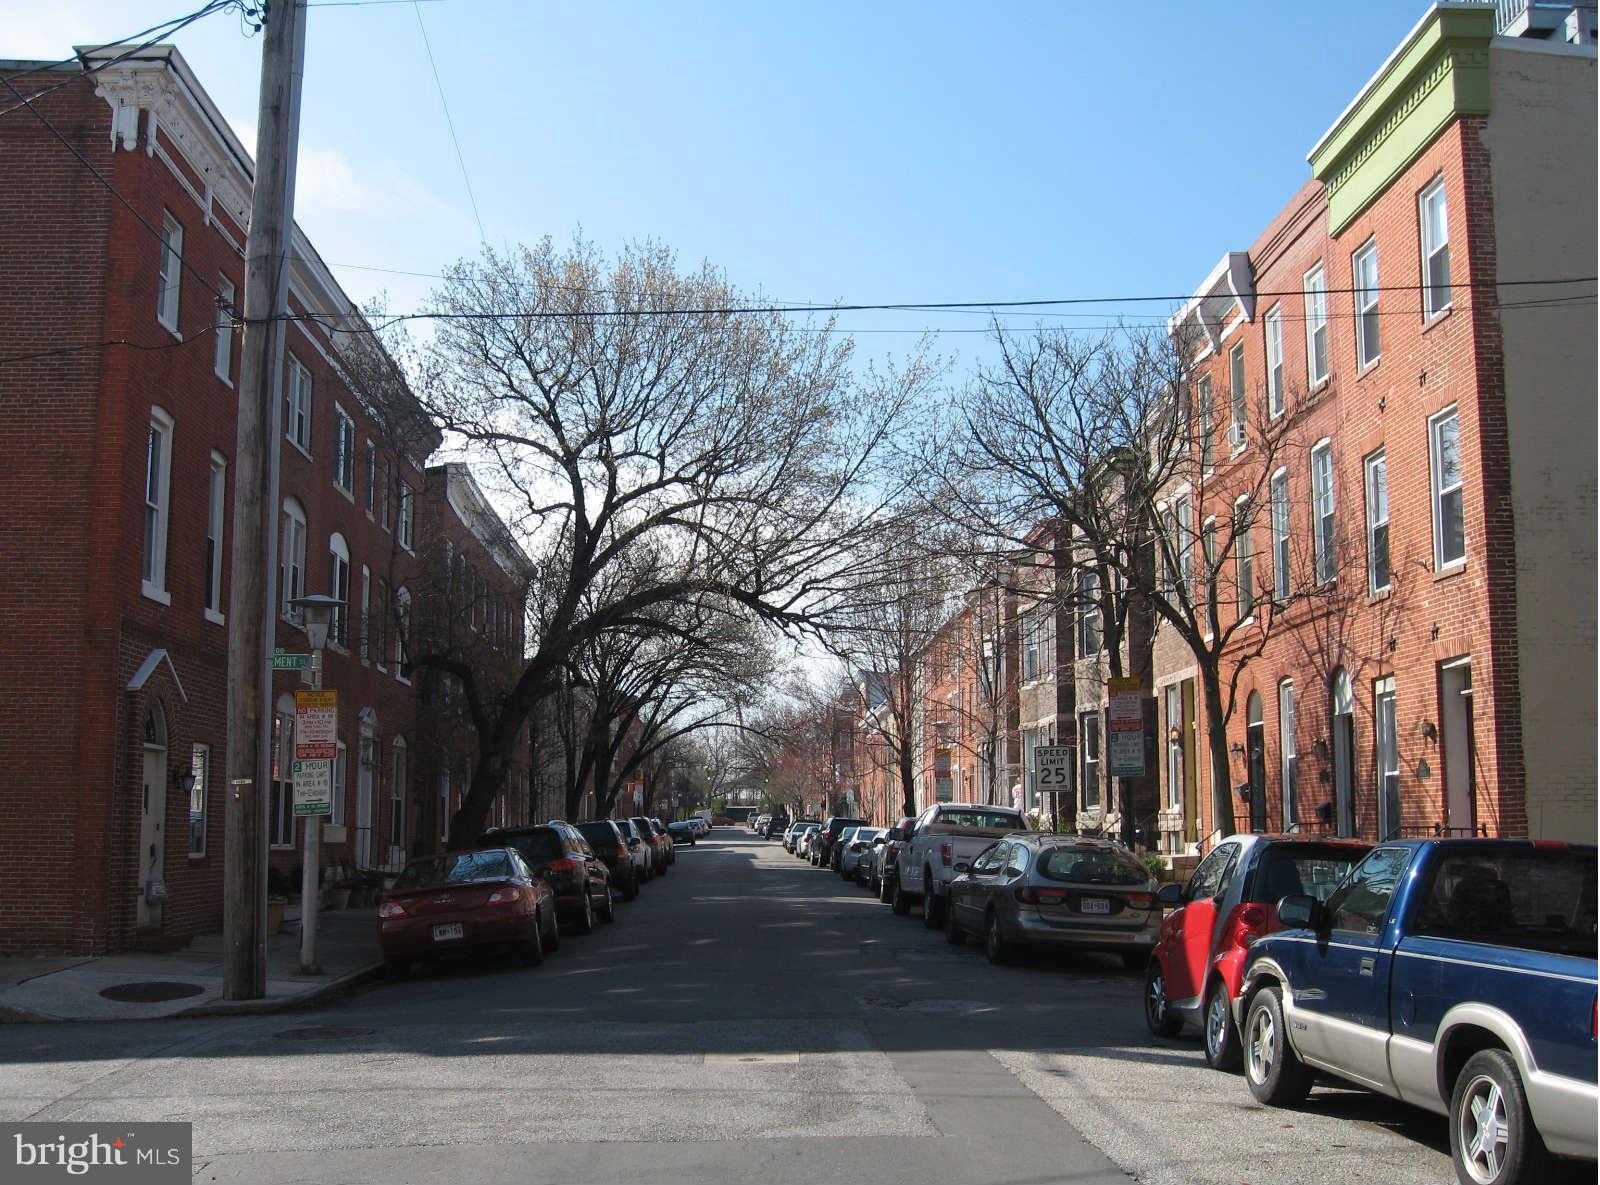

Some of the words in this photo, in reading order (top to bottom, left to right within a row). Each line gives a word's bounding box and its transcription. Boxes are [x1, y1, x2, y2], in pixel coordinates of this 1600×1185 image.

[272, 656, 297, 667] MENT
[1037, 749, 1068, 757] SPEED
[294, 762, 301, 771] 2
[305, 761, 328, 770] HOUR
[1040, 757, 1064, 766] LIMIT
[1040, 767, 1066, 784] 25
